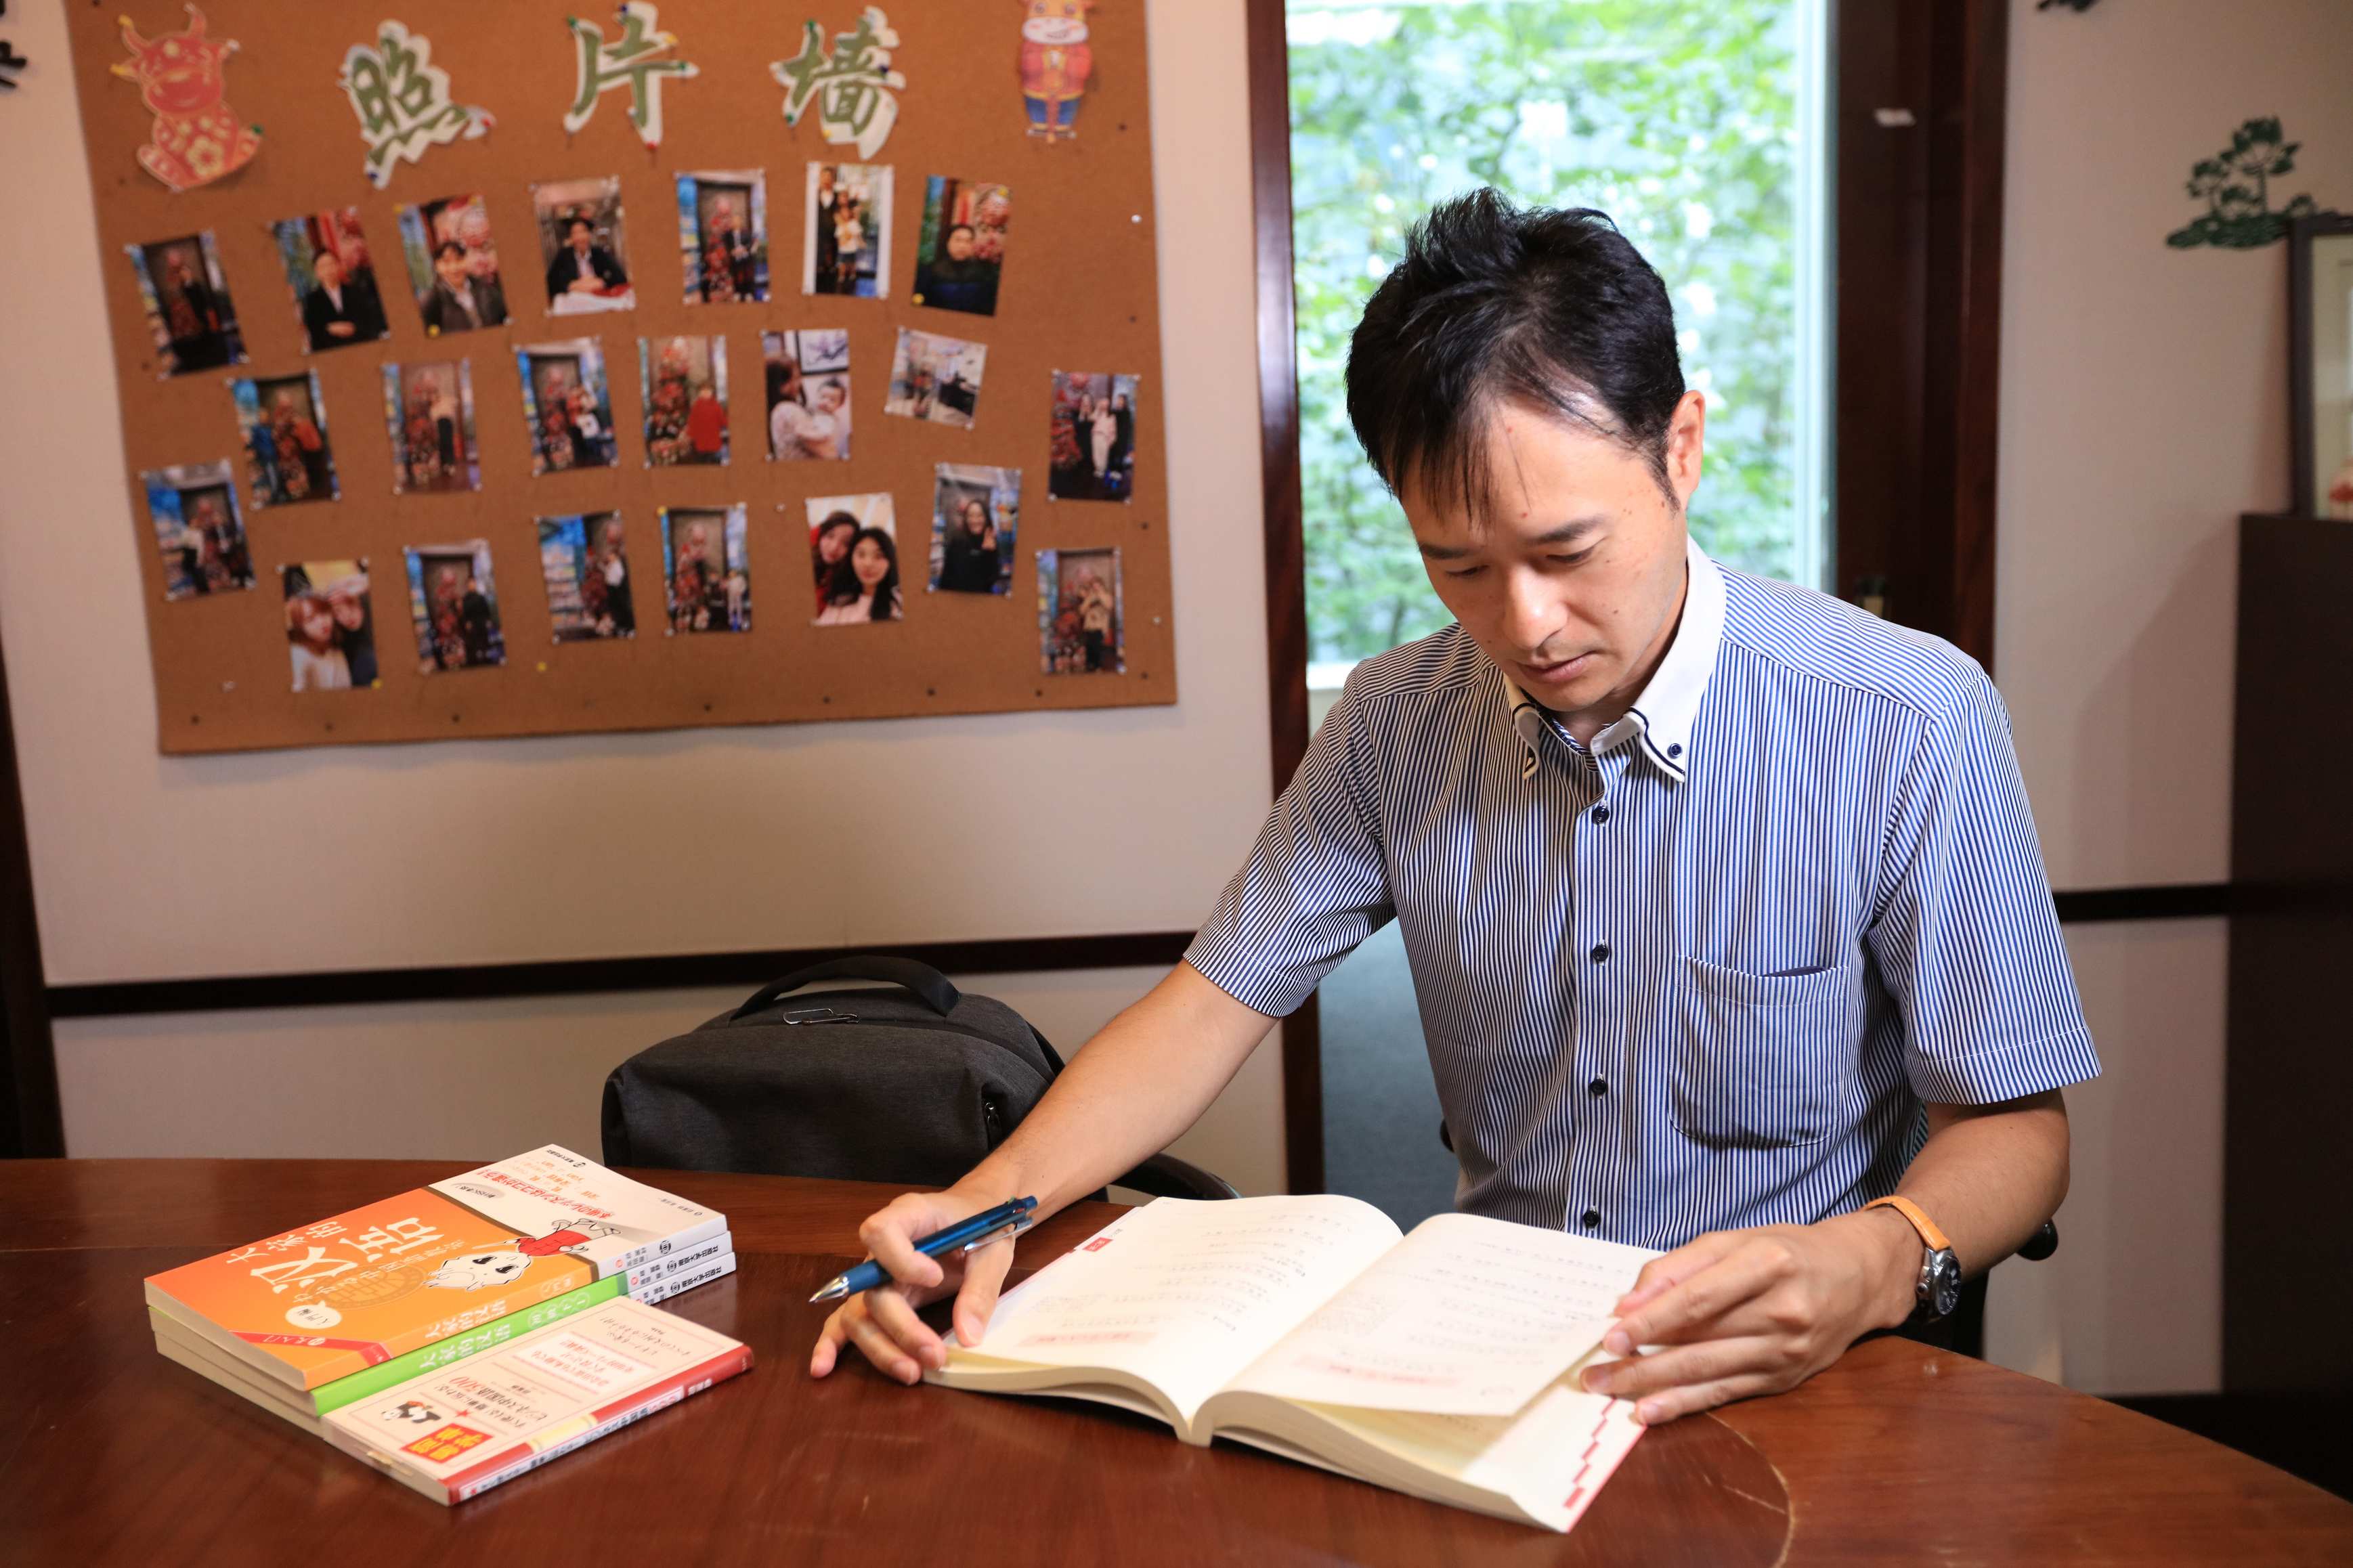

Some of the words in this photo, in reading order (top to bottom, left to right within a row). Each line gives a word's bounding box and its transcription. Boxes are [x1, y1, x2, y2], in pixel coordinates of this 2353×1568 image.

[340, 1, 905, 188] 照片墙
[225, 1221, 349, 1265] 大家的
[250, 1217, 444, 1294] 汉语
[678, 1245, 718, 1266] 南京大学出版社
[293, 1240, 465, 1303] わかる中国語教室
[683, 1266, 722, 1288] 南京大学出版社
[425, 1299, 507, 1338] 大家的汉语
[419, 1324, 511, 1370] 大家的汉语
